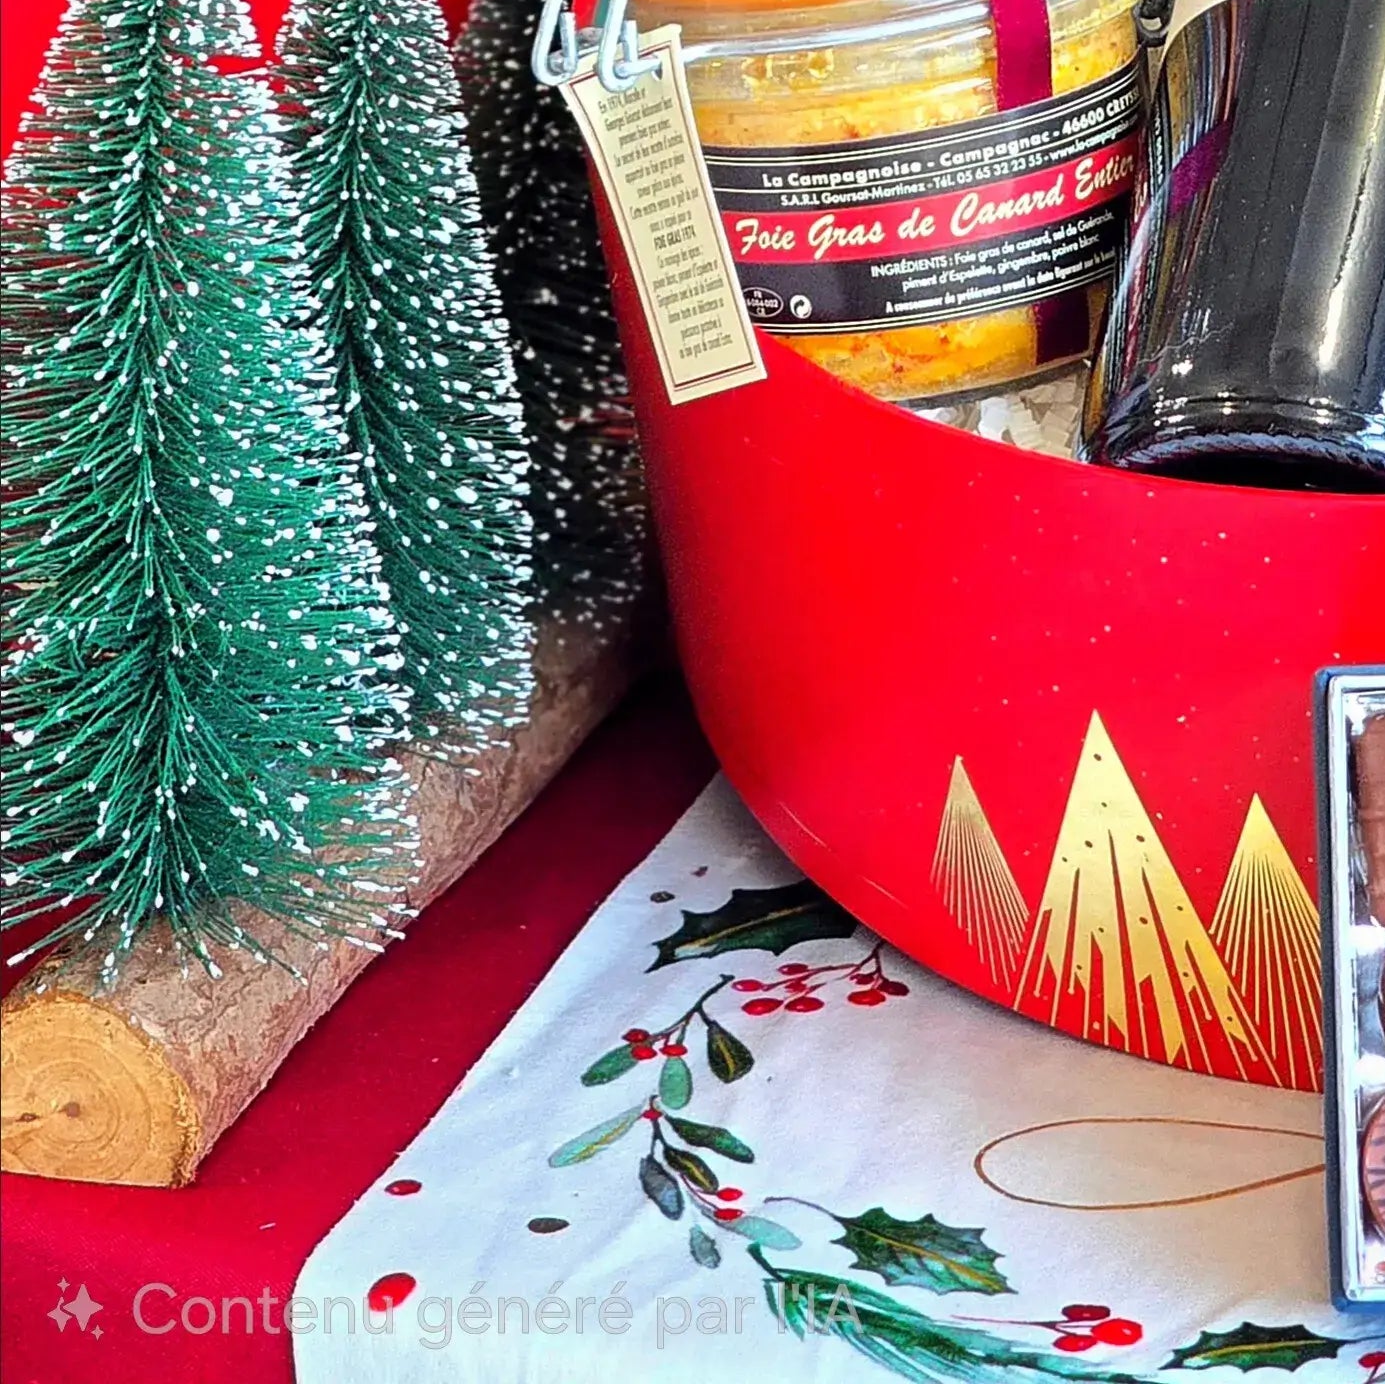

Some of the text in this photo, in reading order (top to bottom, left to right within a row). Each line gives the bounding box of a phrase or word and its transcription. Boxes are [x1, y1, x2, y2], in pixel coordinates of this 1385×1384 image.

[762, 173, 783, 188] La
[787, 160, 922, 187] Campagnoise
[940, 132, 1051, 165] Campagnac
[1062, 106, 1105, 137] 46600
[957, 172, 973, 186] 05
[976, 168, 992, 181] 65
[994, 162, 1010, 176] 32
[1011, 159, 1026, 173] 23
[1028, 155, 1043, 169] 55
[735, 217, 797, 255] Foie
[808, 213, 886, 260] Gras
[897, 206, 936, 240] de
[950, 173, 1065, 237] Canard
[1075, 153, 1135, 200] Entier
[871, 255, 948, 278] INGRÉDIENTS
